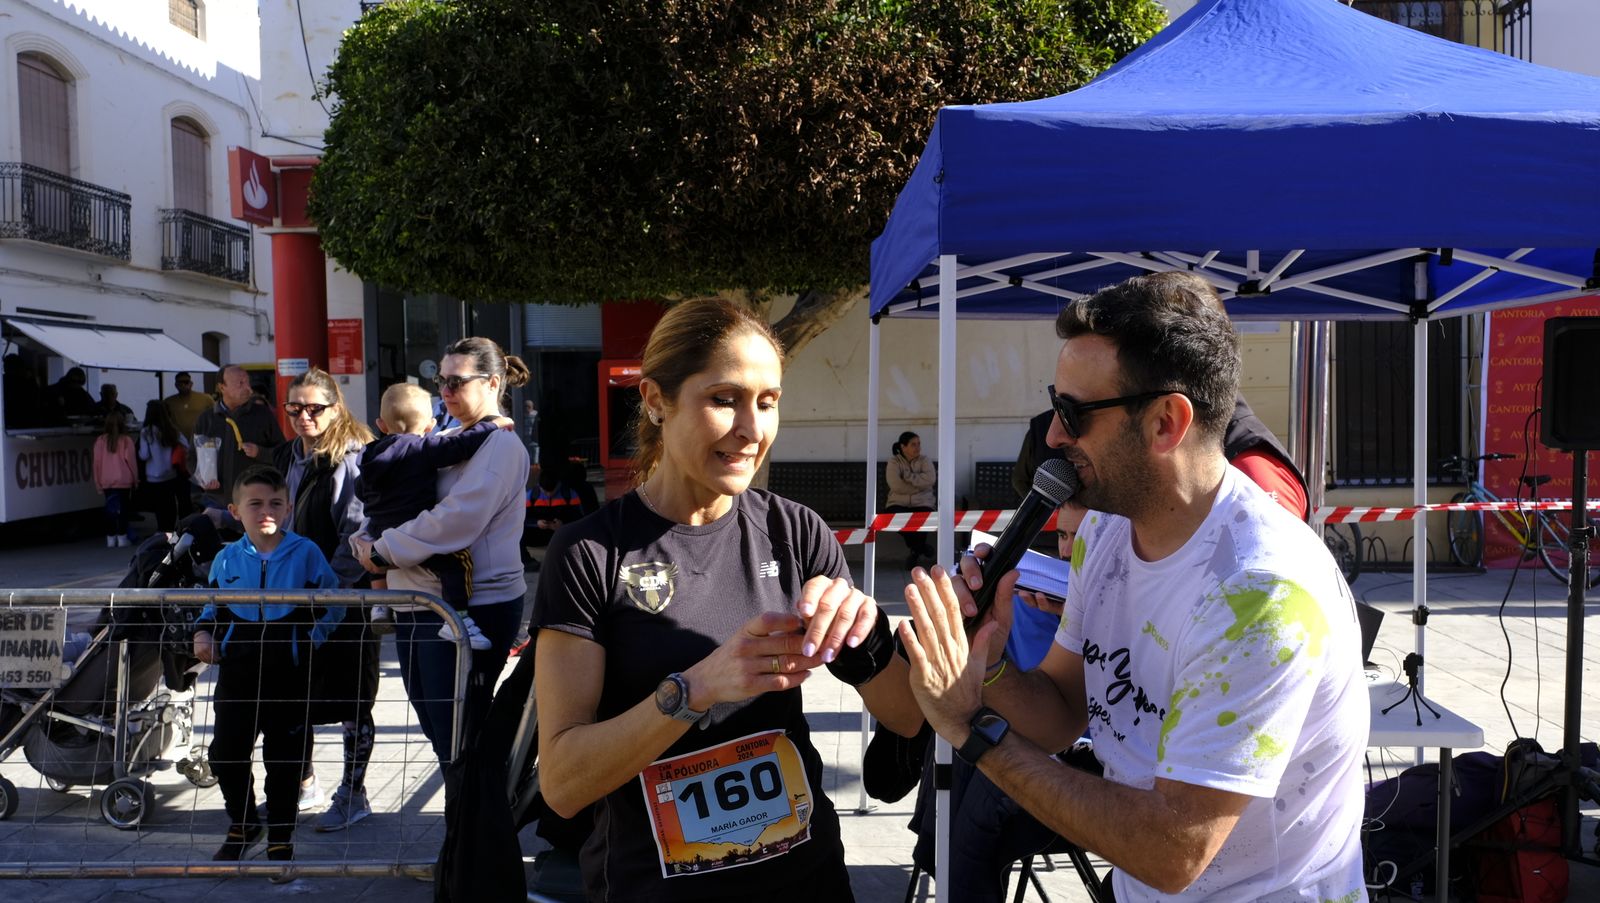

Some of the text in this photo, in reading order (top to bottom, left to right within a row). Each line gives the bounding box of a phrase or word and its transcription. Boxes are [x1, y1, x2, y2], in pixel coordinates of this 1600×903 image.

[0, 613, 55, 631] ER DE
[27, 670, 52, 683] 550
[735, 738, 770, 754] CANTORIA
[737, 750, 754, 761] 2024
[660, 770, 673, 781] LA
[678, 760, 782, 820] 160
[739, 811, 768, 825] GADOR
